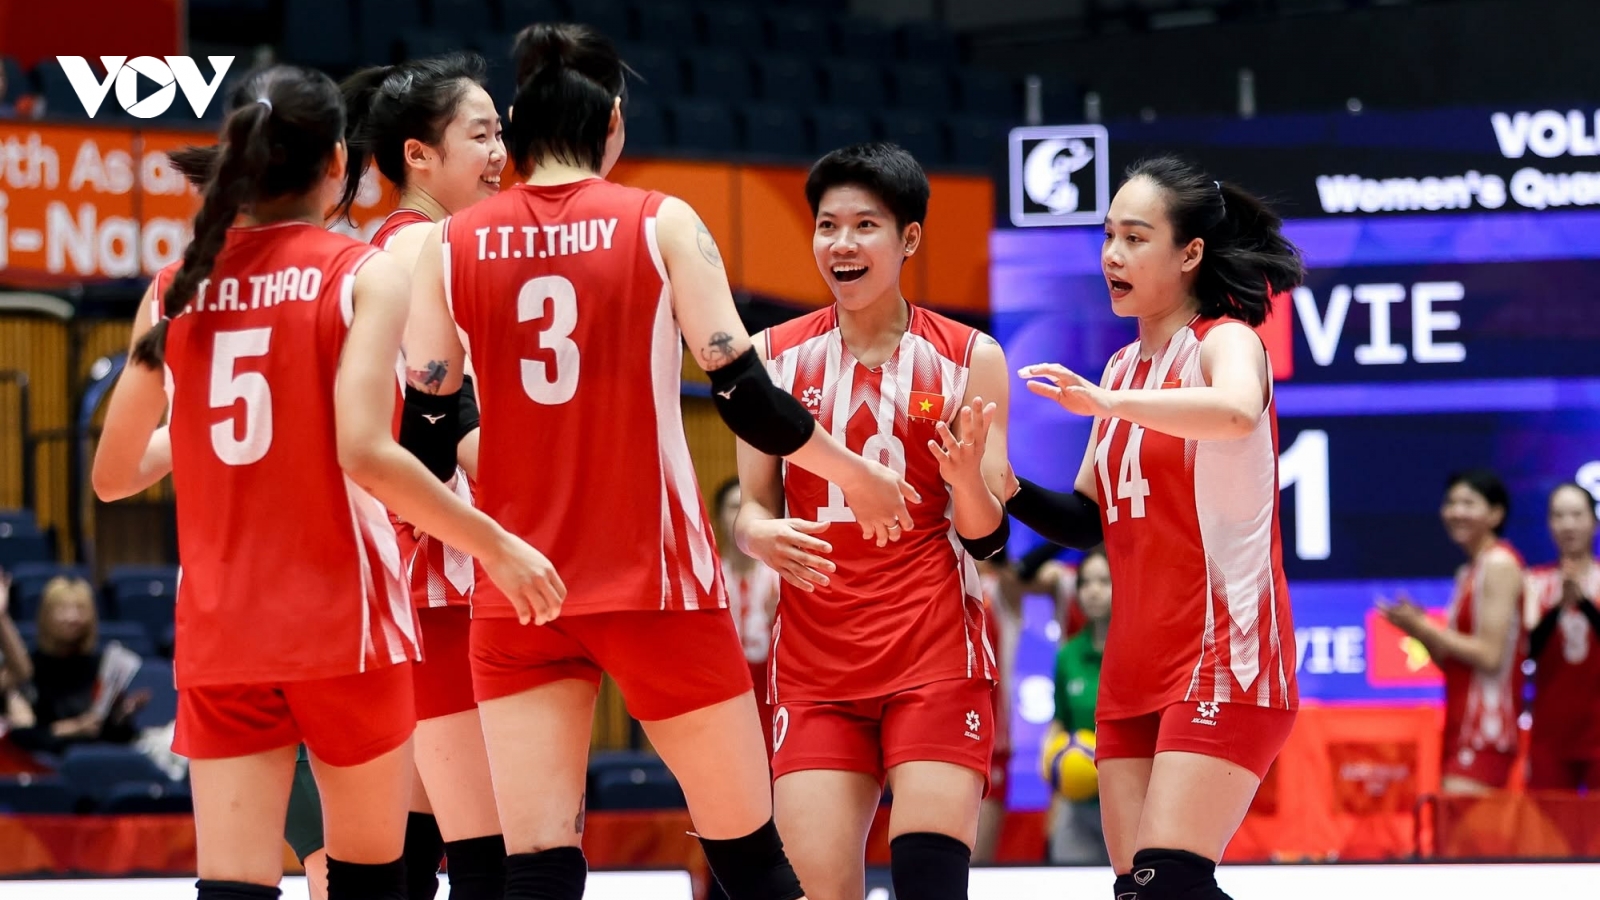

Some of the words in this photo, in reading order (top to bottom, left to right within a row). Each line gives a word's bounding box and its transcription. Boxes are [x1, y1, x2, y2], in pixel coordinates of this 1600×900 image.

[0, 131, 60, 190] th
[1491, 109, 1600, 159] VOL
[1315, 169, 1507, 213] Women's
[475, 217, 619, 261] T.T.T.THUY
[174, 266, 323, 319] .T.A.THAO
[1291, 281, 1467, 367] VIE
[517, 275, 581, 405] 3
[209, 326, 273, 466] 5
[1094, 416, 1151, 525] 14
[1278, 428, 1331, 560] 1
